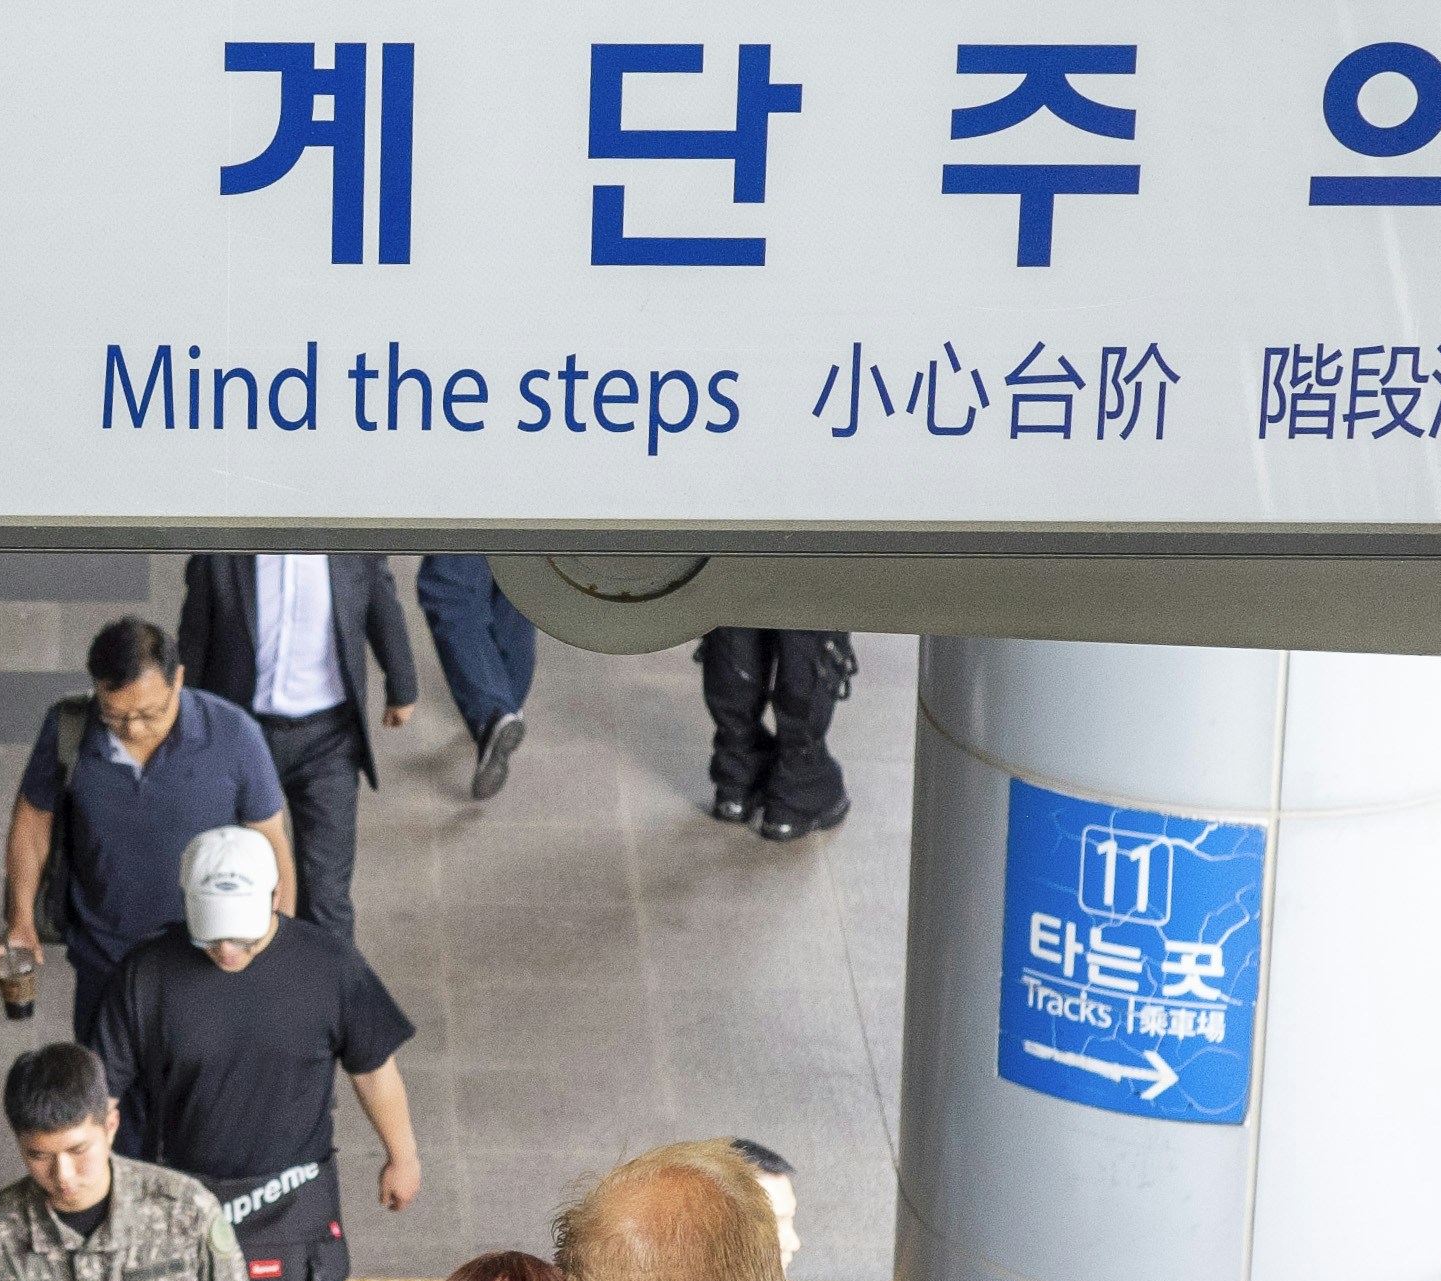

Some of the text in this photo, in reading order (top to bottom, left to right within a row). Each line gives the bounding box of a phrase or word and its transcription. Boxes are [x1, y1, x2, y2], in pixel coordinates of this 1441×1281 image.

[100, 340, 742, 459] Mind the steps
[811, 341, 1180, 440] 小心台阶
[1097, 839, 1151, 913] 11
[1029, 911, 1225, 1000] 타는 곳
[1021, 976, 1113, 1029] Tracks
